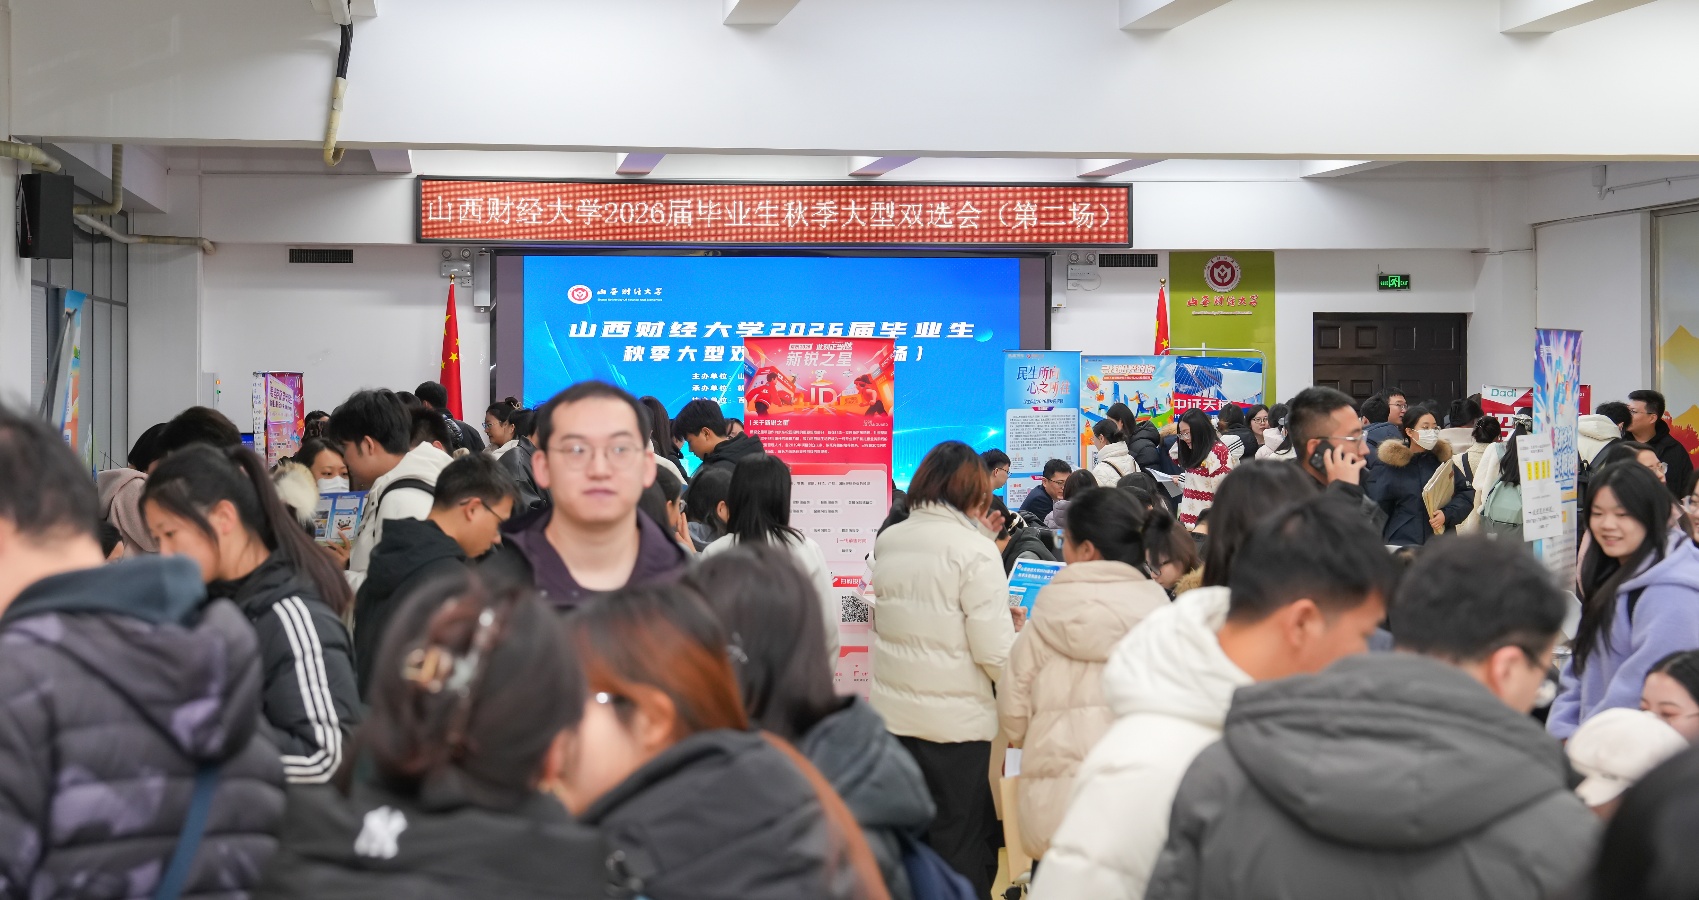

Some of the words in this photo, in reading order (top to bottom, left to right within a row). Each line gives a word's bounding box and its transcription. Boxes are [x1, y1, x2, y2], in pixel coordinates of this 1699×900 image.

[428, 196, 1110, 230] 山西财经大学2026届毕业生秋季大型双选会（第二场）
[568, 321, 975, 338] 山西财经大学2026届毕业生
[786, 351, 852, 367] 新锐之星
[1016, 365, 1060, 380] 民生所向
[1027, 380, 1070, 397] 心之所往
[1491, 388, 1517, 397] Dadi
